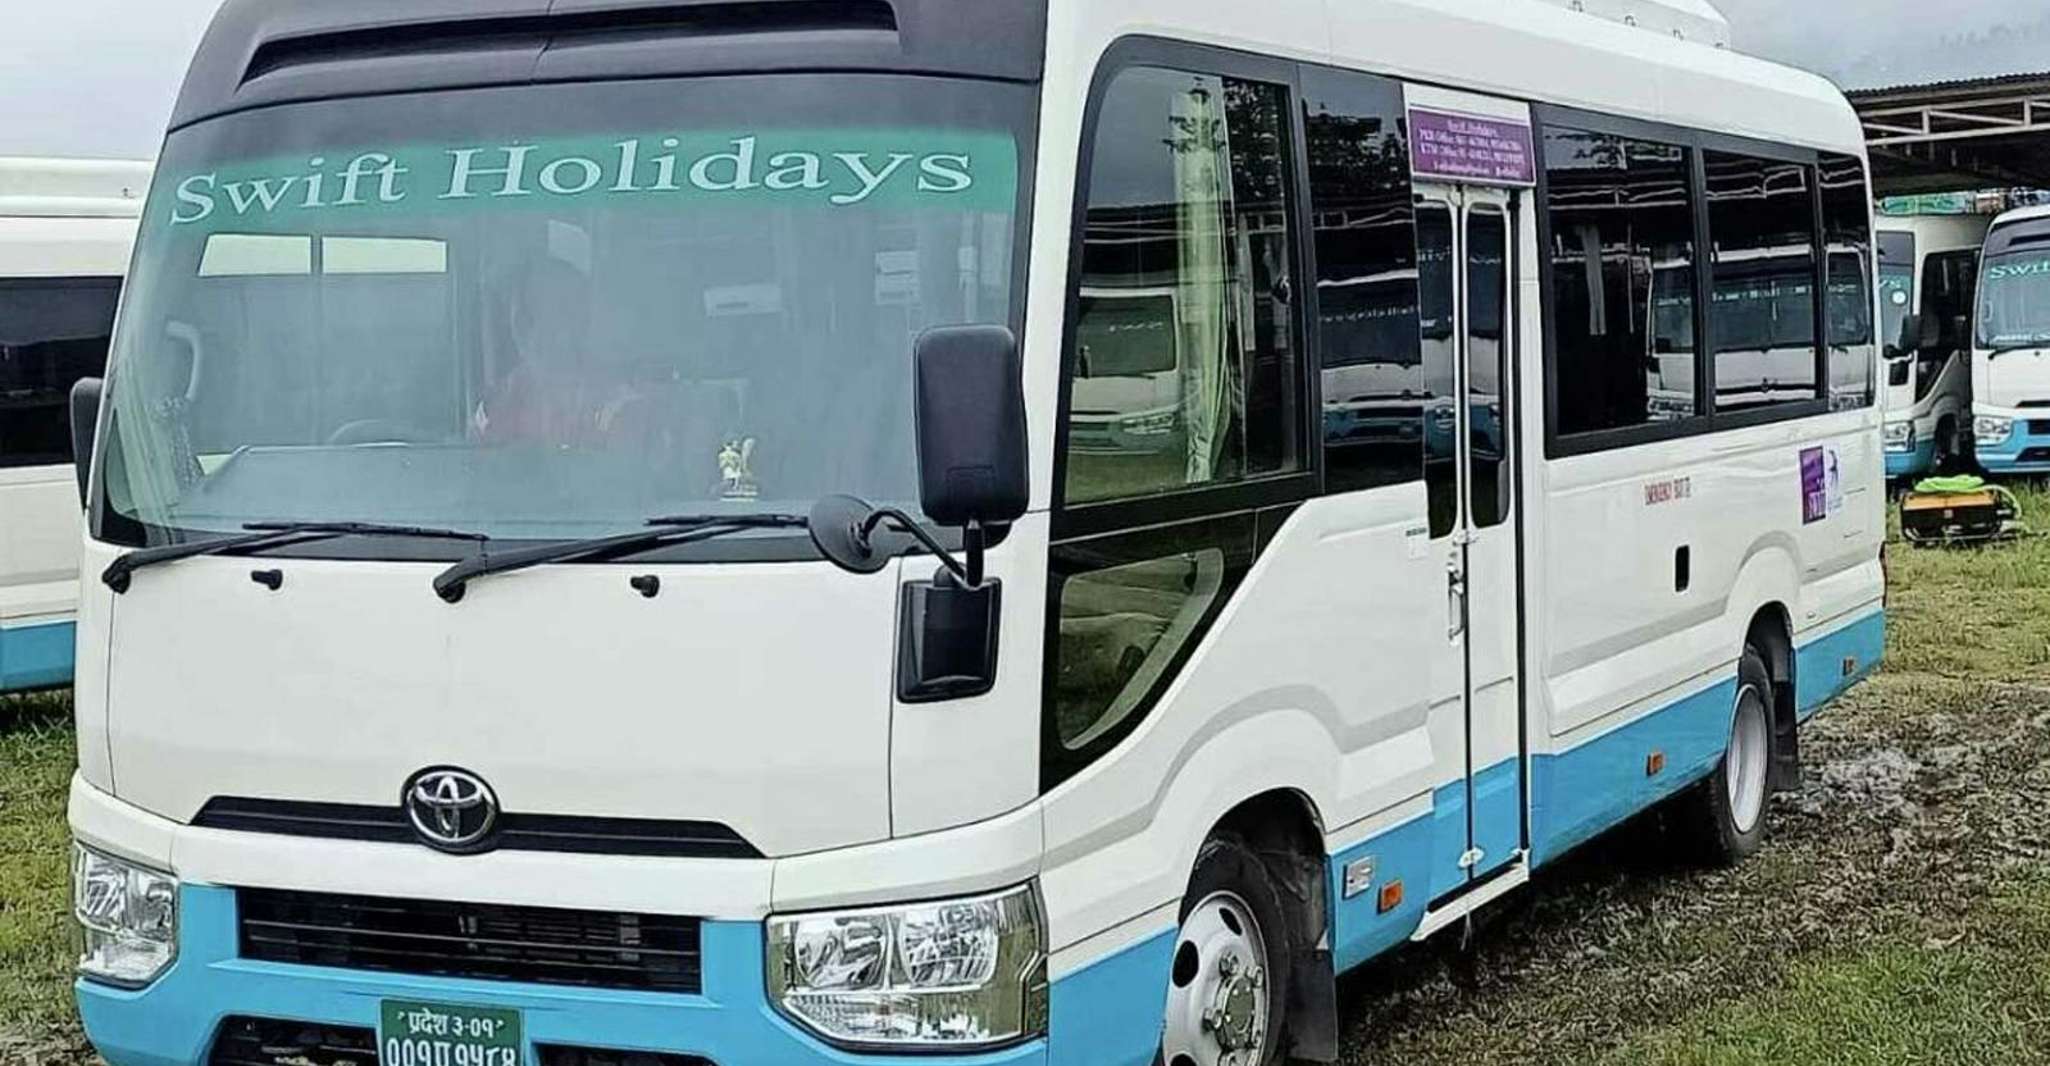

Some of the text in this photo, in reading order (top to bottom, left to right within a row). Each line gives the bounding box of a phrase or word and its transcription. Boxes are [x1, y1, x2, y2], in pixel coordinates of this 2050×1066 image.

[170, 136, 973, 227] Swift Holidays
[408, 1008, 449, 1036] प्रदेश
